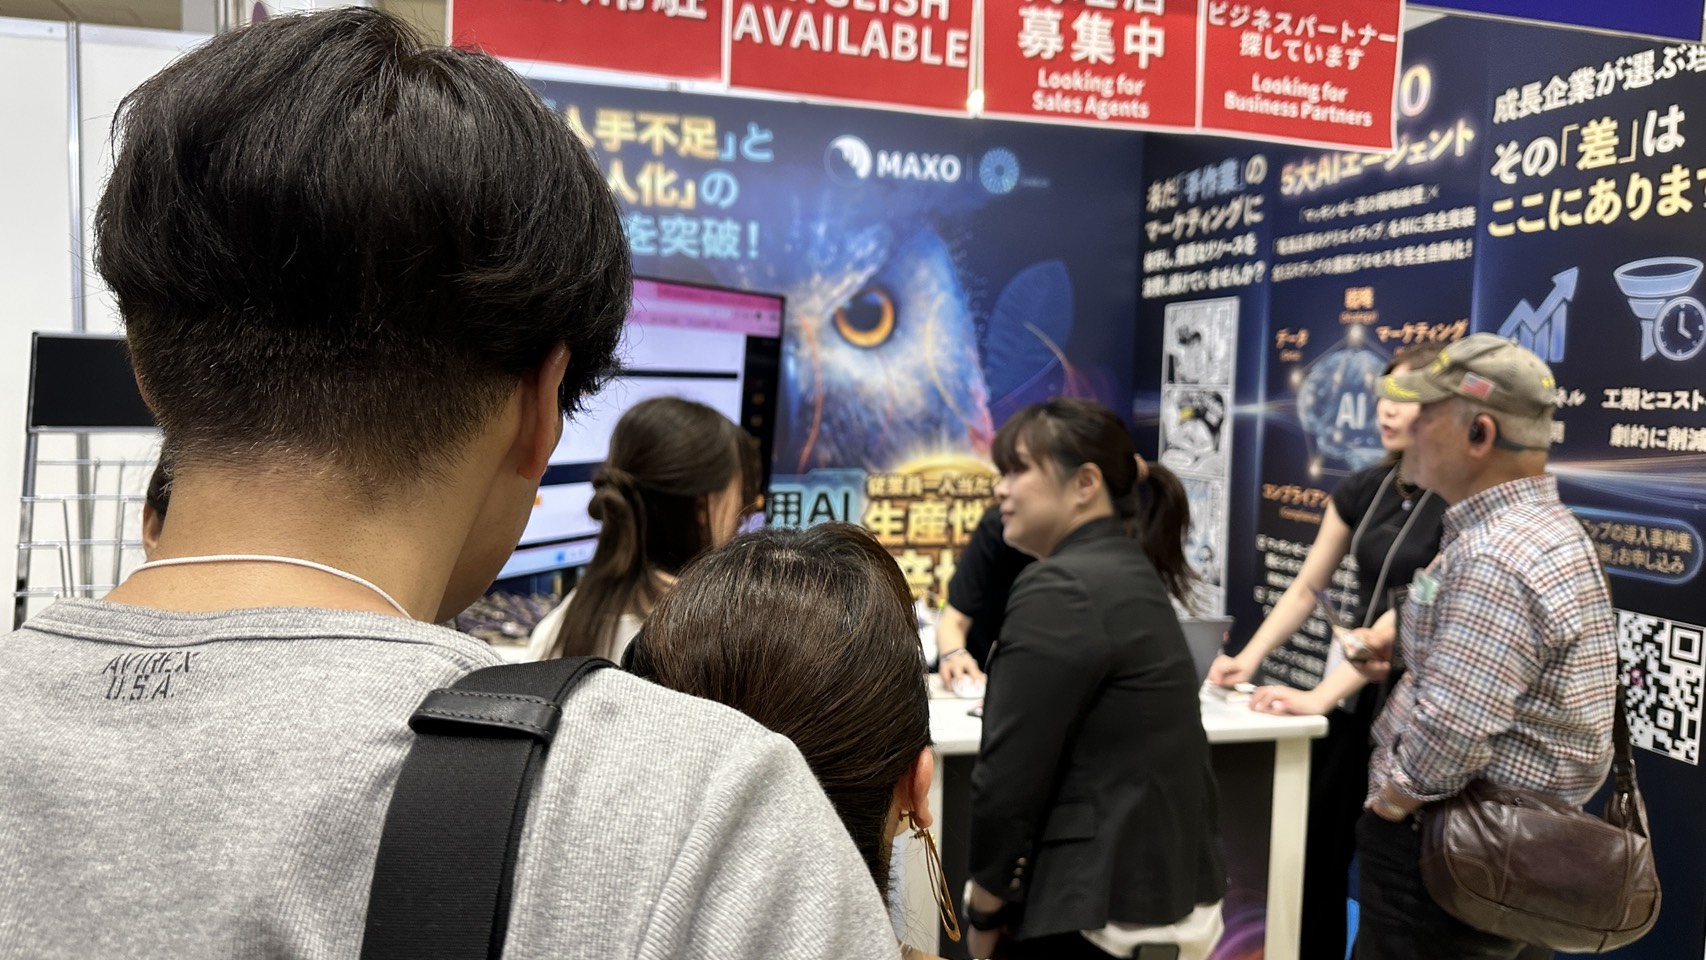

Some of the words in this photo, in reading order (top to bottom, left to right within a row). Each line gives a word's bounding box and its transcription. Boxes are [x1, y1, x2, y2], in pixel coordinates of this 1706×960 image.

[732, 3, 970, 68] AVAILABLE
[1018, 5, 1166, 70] 募集中
[1208, 1, 1398, 47] ビジネスパートナー
[1239, 30, 1366, 71] 探しています
[1038, 66, 1114, 98] Looking
[1116, 72, 1146, 96] for
[1251, 72, 1321, 104] Looking
[1321, 80, 1349, 103] for
[1032, 89, 1083, 114] Sales
[1084, 94, 1150, 121] Agents
[1224, 90, 1299, 118] Business
[1300, 101, 1373, 127] Partners
[1491, 103, 1686, 185] その「差」は
[877, 149, 962, 183] MAXO
[1144, 193, 1265, 243] マーケティングに
[1376, 318, 1470, 344] マーケティング
[1335, 392, 1367, 431] AI
[1601, 386, 1706, 412] 工期とコスト
